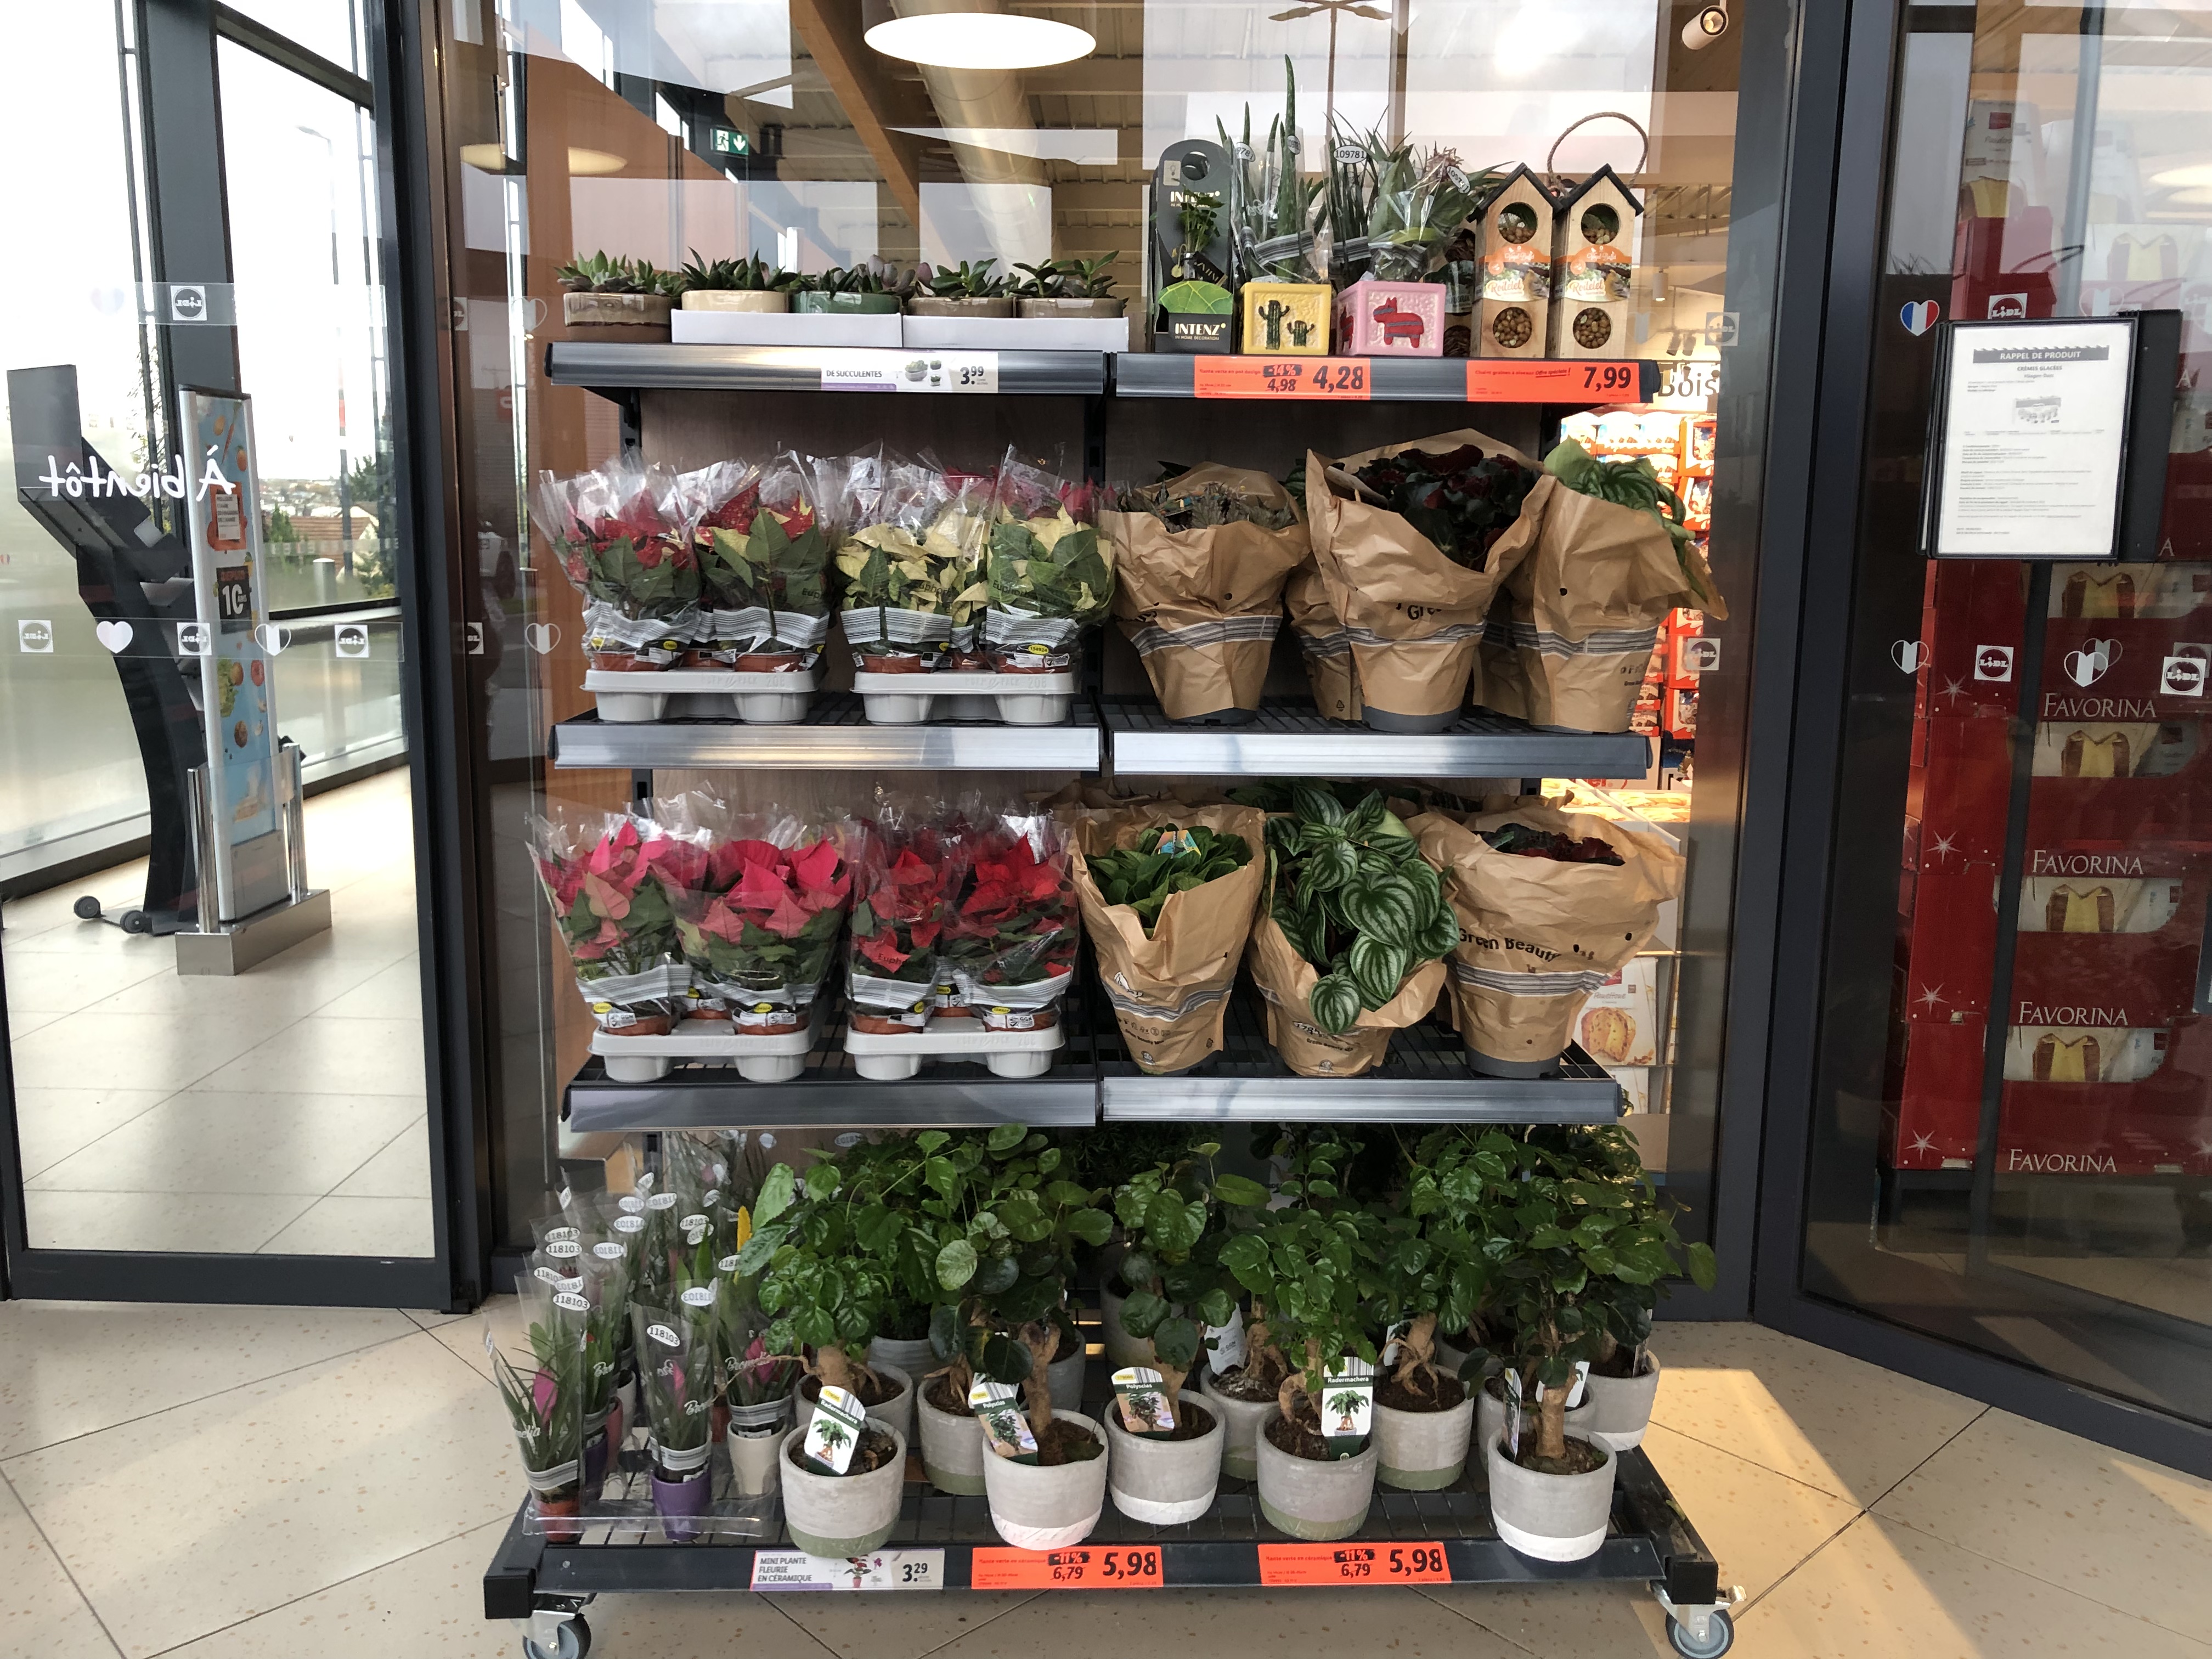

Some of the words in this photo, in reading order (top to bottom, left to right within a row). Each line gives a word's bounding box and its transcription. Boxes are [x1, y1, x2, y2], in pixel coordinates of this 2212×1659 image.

[1335, 149, 1365, 159] 109781
[1175, 323, 1220, 336] INTENZ
[2044, 351, 2081, 359] PRODUIT
[1268, 364, 1296, 376] -14%
[1267, 378, 1297, 392] 4,98
[1313, 365, 1363, 393] 4,28
[1583, 366, 1632, 392] 7,99
[2044, 692, 2157, 718] FAVORINA
[2032, 850, 2145, 875] FAVORINA
[1459, 927, 1499, 950] Green
[2018, 1001, 2129, 1026] FAVORINA
[2008, 1148, 2117, 1173] FAVORINA
[548, 1245, 580, 1254] 118103
[555, 1295, 589, 1309] 118103
[649, 1326, 679, 1345] 118103
[820, 1399, 858, 1424] Radermachera
[983, 1400, 1006, 1409] Polyscias
[1054, 1552, 1083, 1564] -11%
[1340, 1549, 1368, 1561] -11%
[1390, 1548, 1443, 1577] 5,98
[1102, 1551, 1157, 1580] 5,98
[1341, 1564, 1370, 1578] 6,79
[768, 1573, 812, 1583] CÉRAMIQUE
[1053, 1566, 1084, 1582] 6,79
